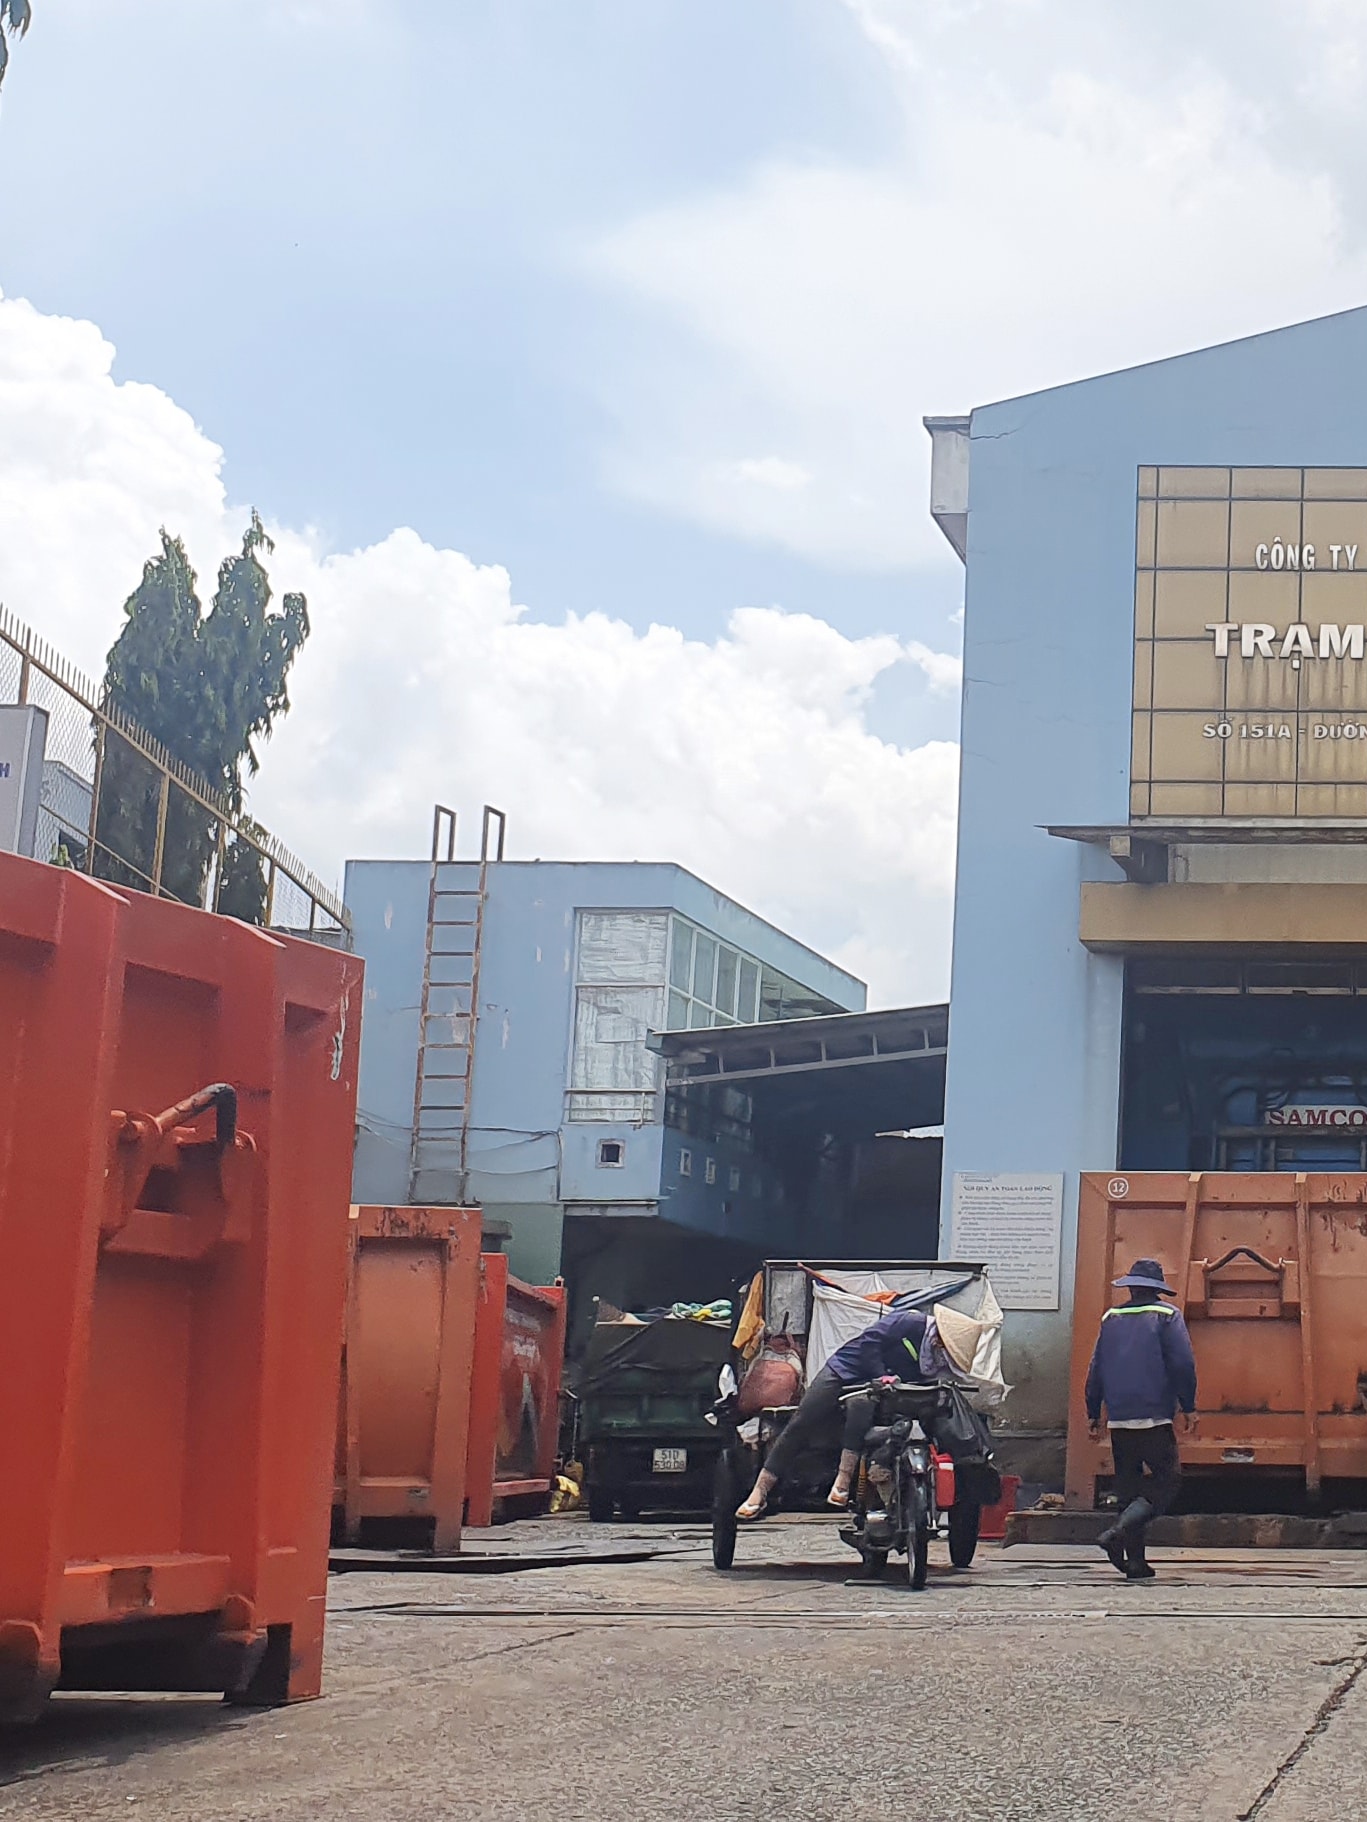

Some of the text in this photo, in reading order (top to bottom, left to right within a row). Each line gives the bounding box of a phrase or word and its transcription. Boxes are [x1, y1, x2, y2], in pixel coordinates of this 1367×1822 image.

[1255, 536, 1316, 571] CÔNG
[1329, 544, 1358, 571] TY
[1205, 623, 1365, 671] TRẠM
[1202, 716, 1234, 738] SỐ
[1239, 723, 1292, 739] 151A
[1112, 1182, 1125, 1193] 12
